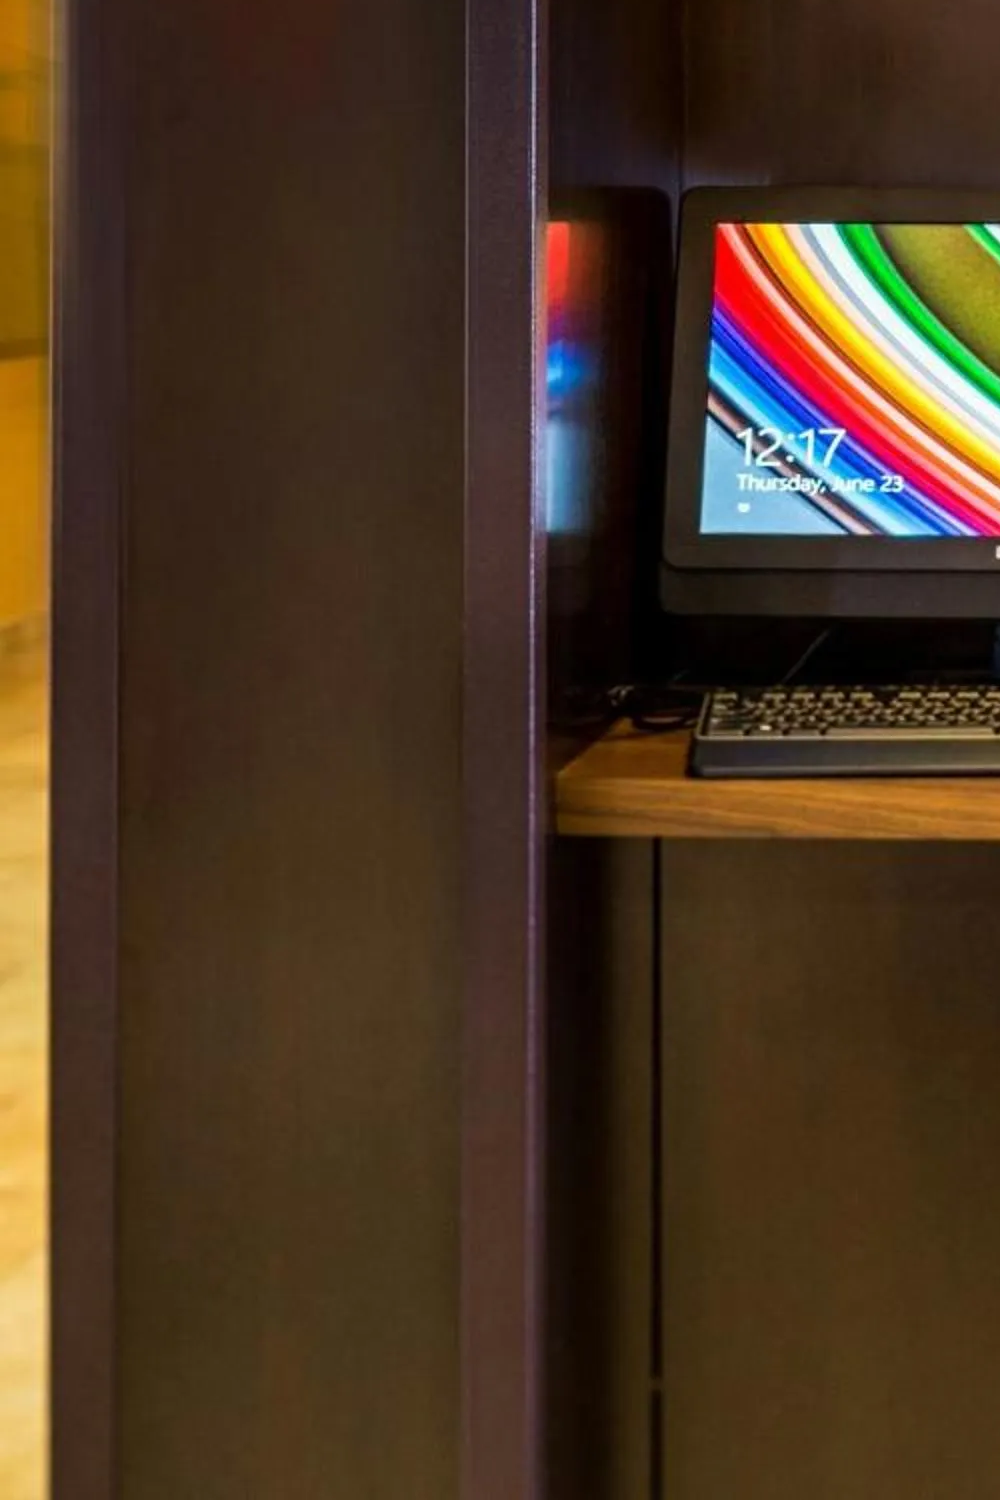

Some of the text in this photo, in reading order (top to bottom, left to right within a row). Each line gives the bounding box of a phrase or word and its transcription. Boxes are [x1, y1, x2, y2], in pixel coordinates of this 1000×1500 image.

[736, 427, 847, 468] 12:17
[736, 473, 904, 495] Thursday, June 23
